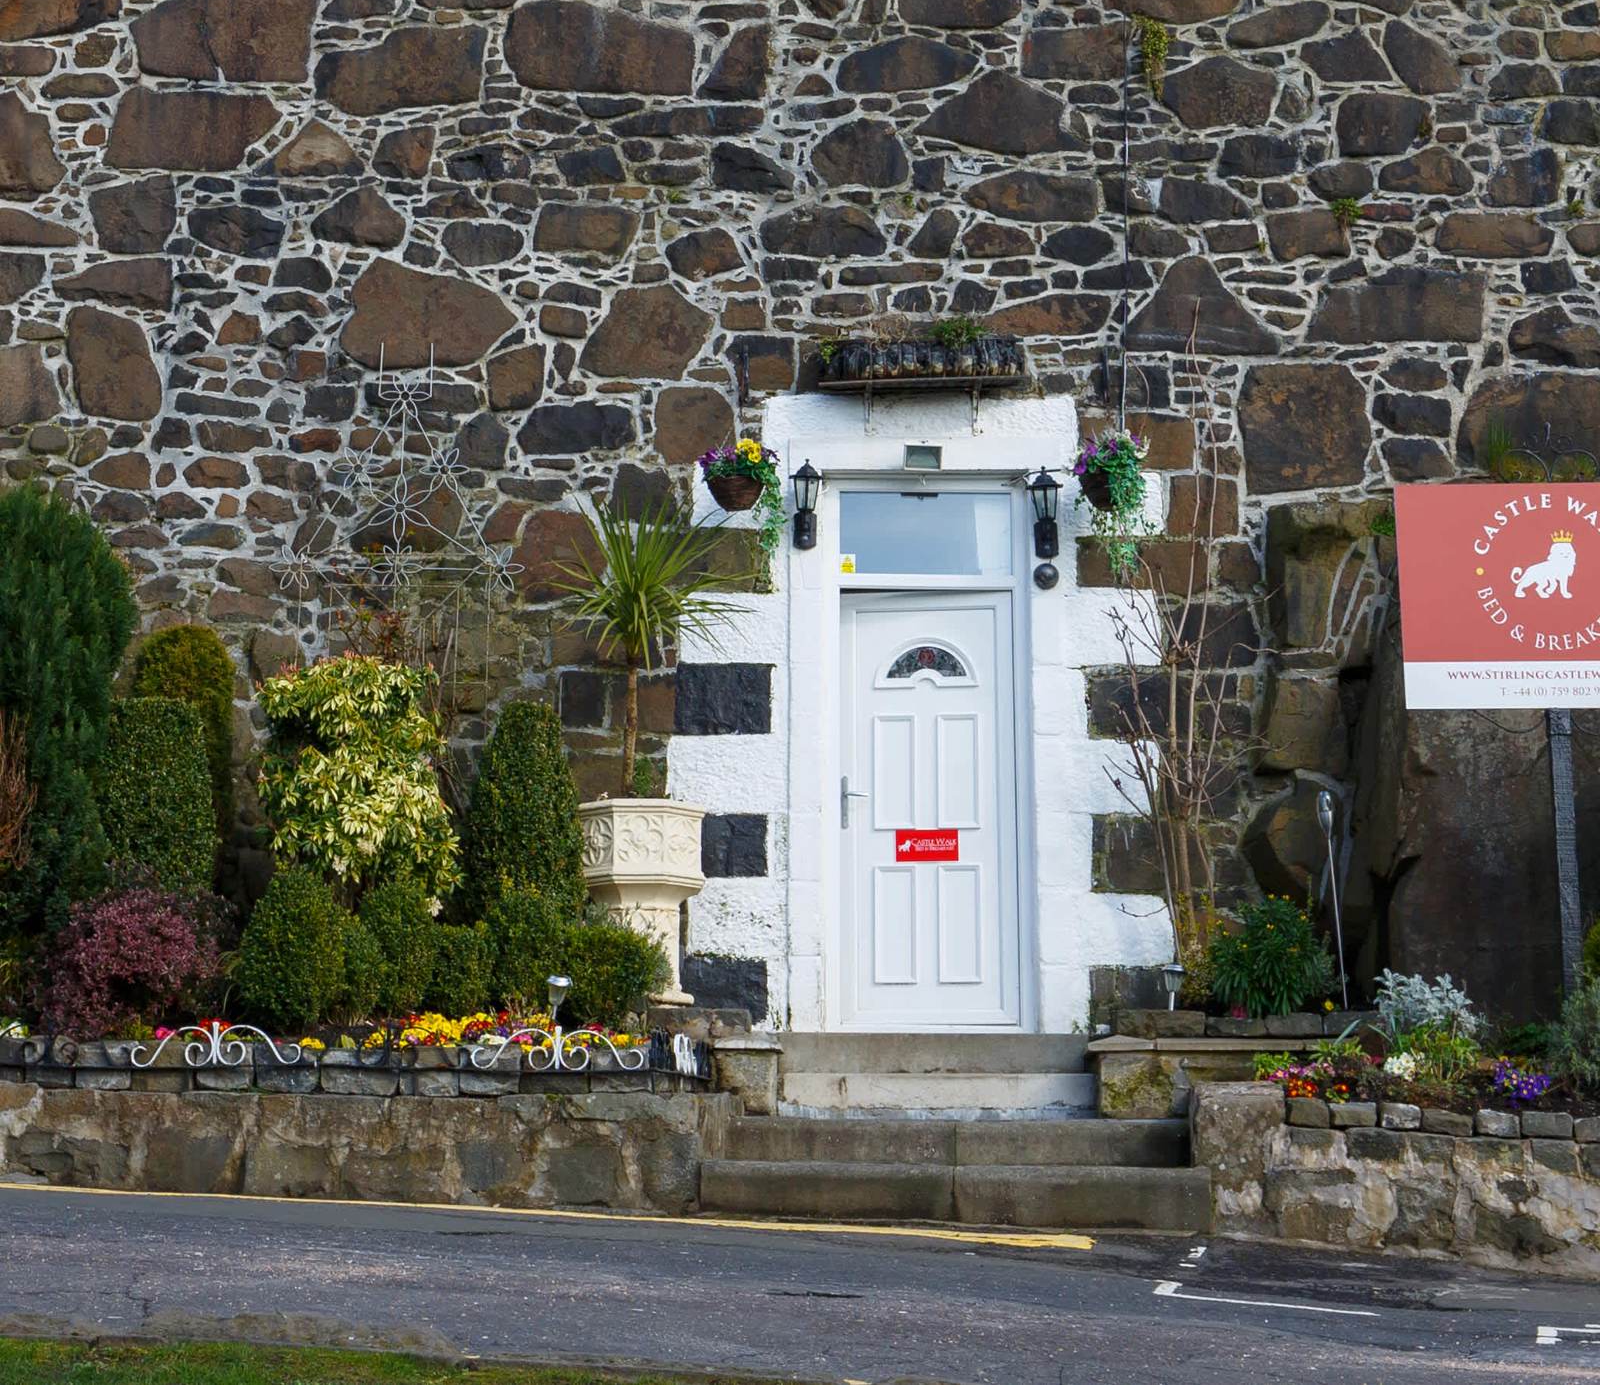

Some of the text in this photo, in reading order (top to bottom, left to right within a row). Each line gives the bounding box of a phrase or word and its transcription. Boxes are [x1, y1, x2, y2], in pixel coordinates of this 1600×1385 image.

[1474, 493, 1600, 555] CASTLE WA
[1477, 586, 1600, 651] BED & BREAK
[1500, 686, 1510, 696] T:
[1513, 686, 1531, 696] +44
[1533, 686, 1548, 697] (0)
[1551, 686, 1570, 696] 759
[1572, 686, 1591, 696] 802
